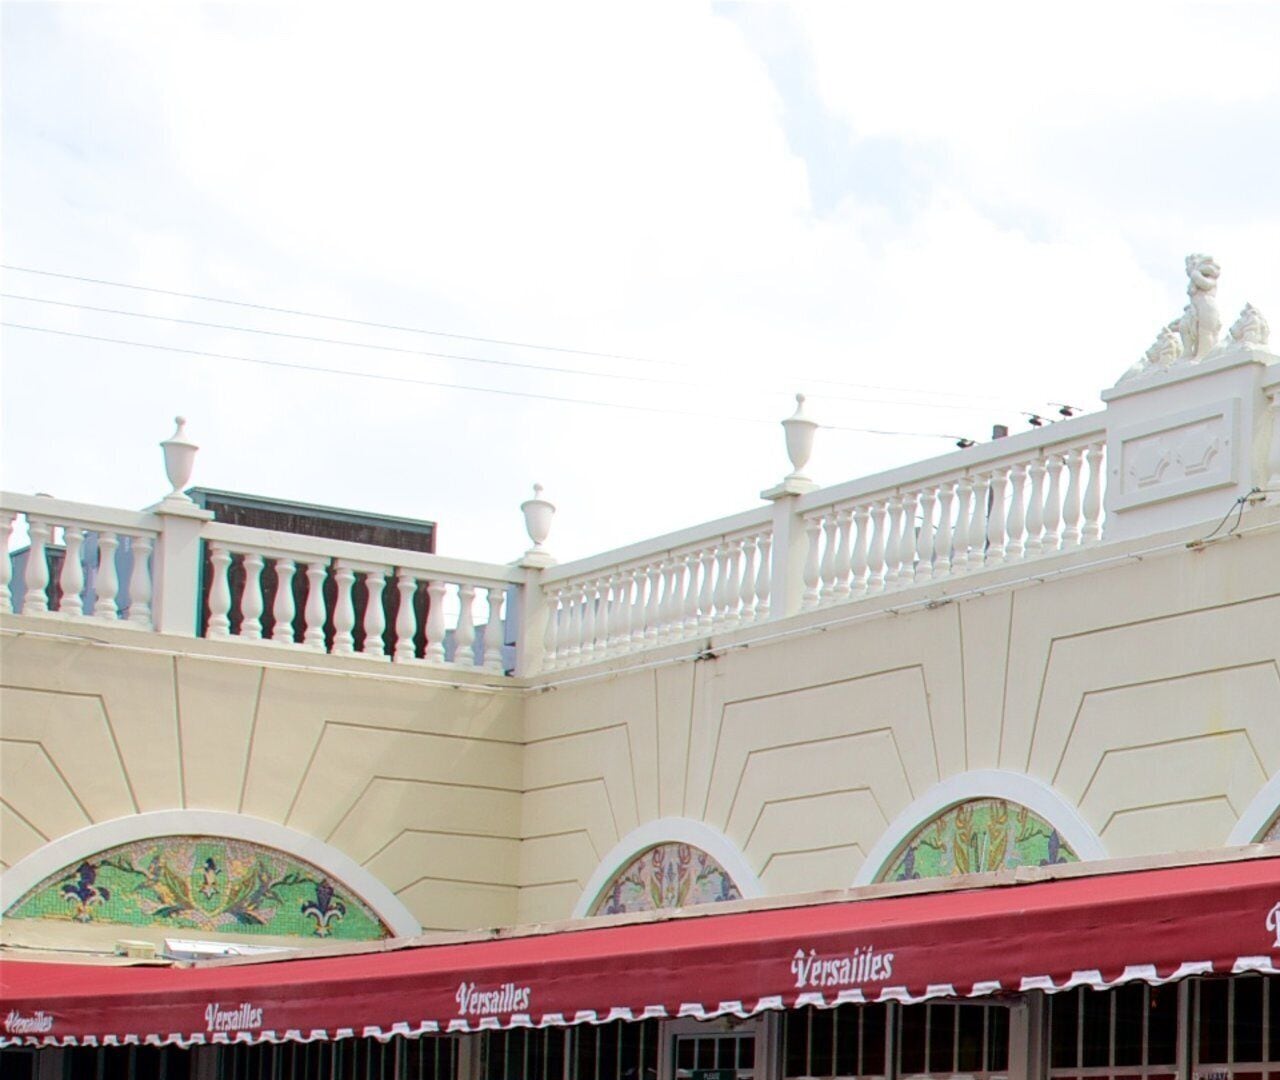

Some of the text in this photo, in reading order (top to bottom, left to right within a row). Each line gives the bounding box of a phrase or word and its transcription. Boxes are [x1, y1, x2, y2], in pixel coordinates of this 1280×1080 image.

[791, 945, 894, 988] Versailles
[455, 981, 531, 1016] Versailles
[4, 1010, 54, 1034] Versailles
[204, 1002, 263, 1032] Versailles
